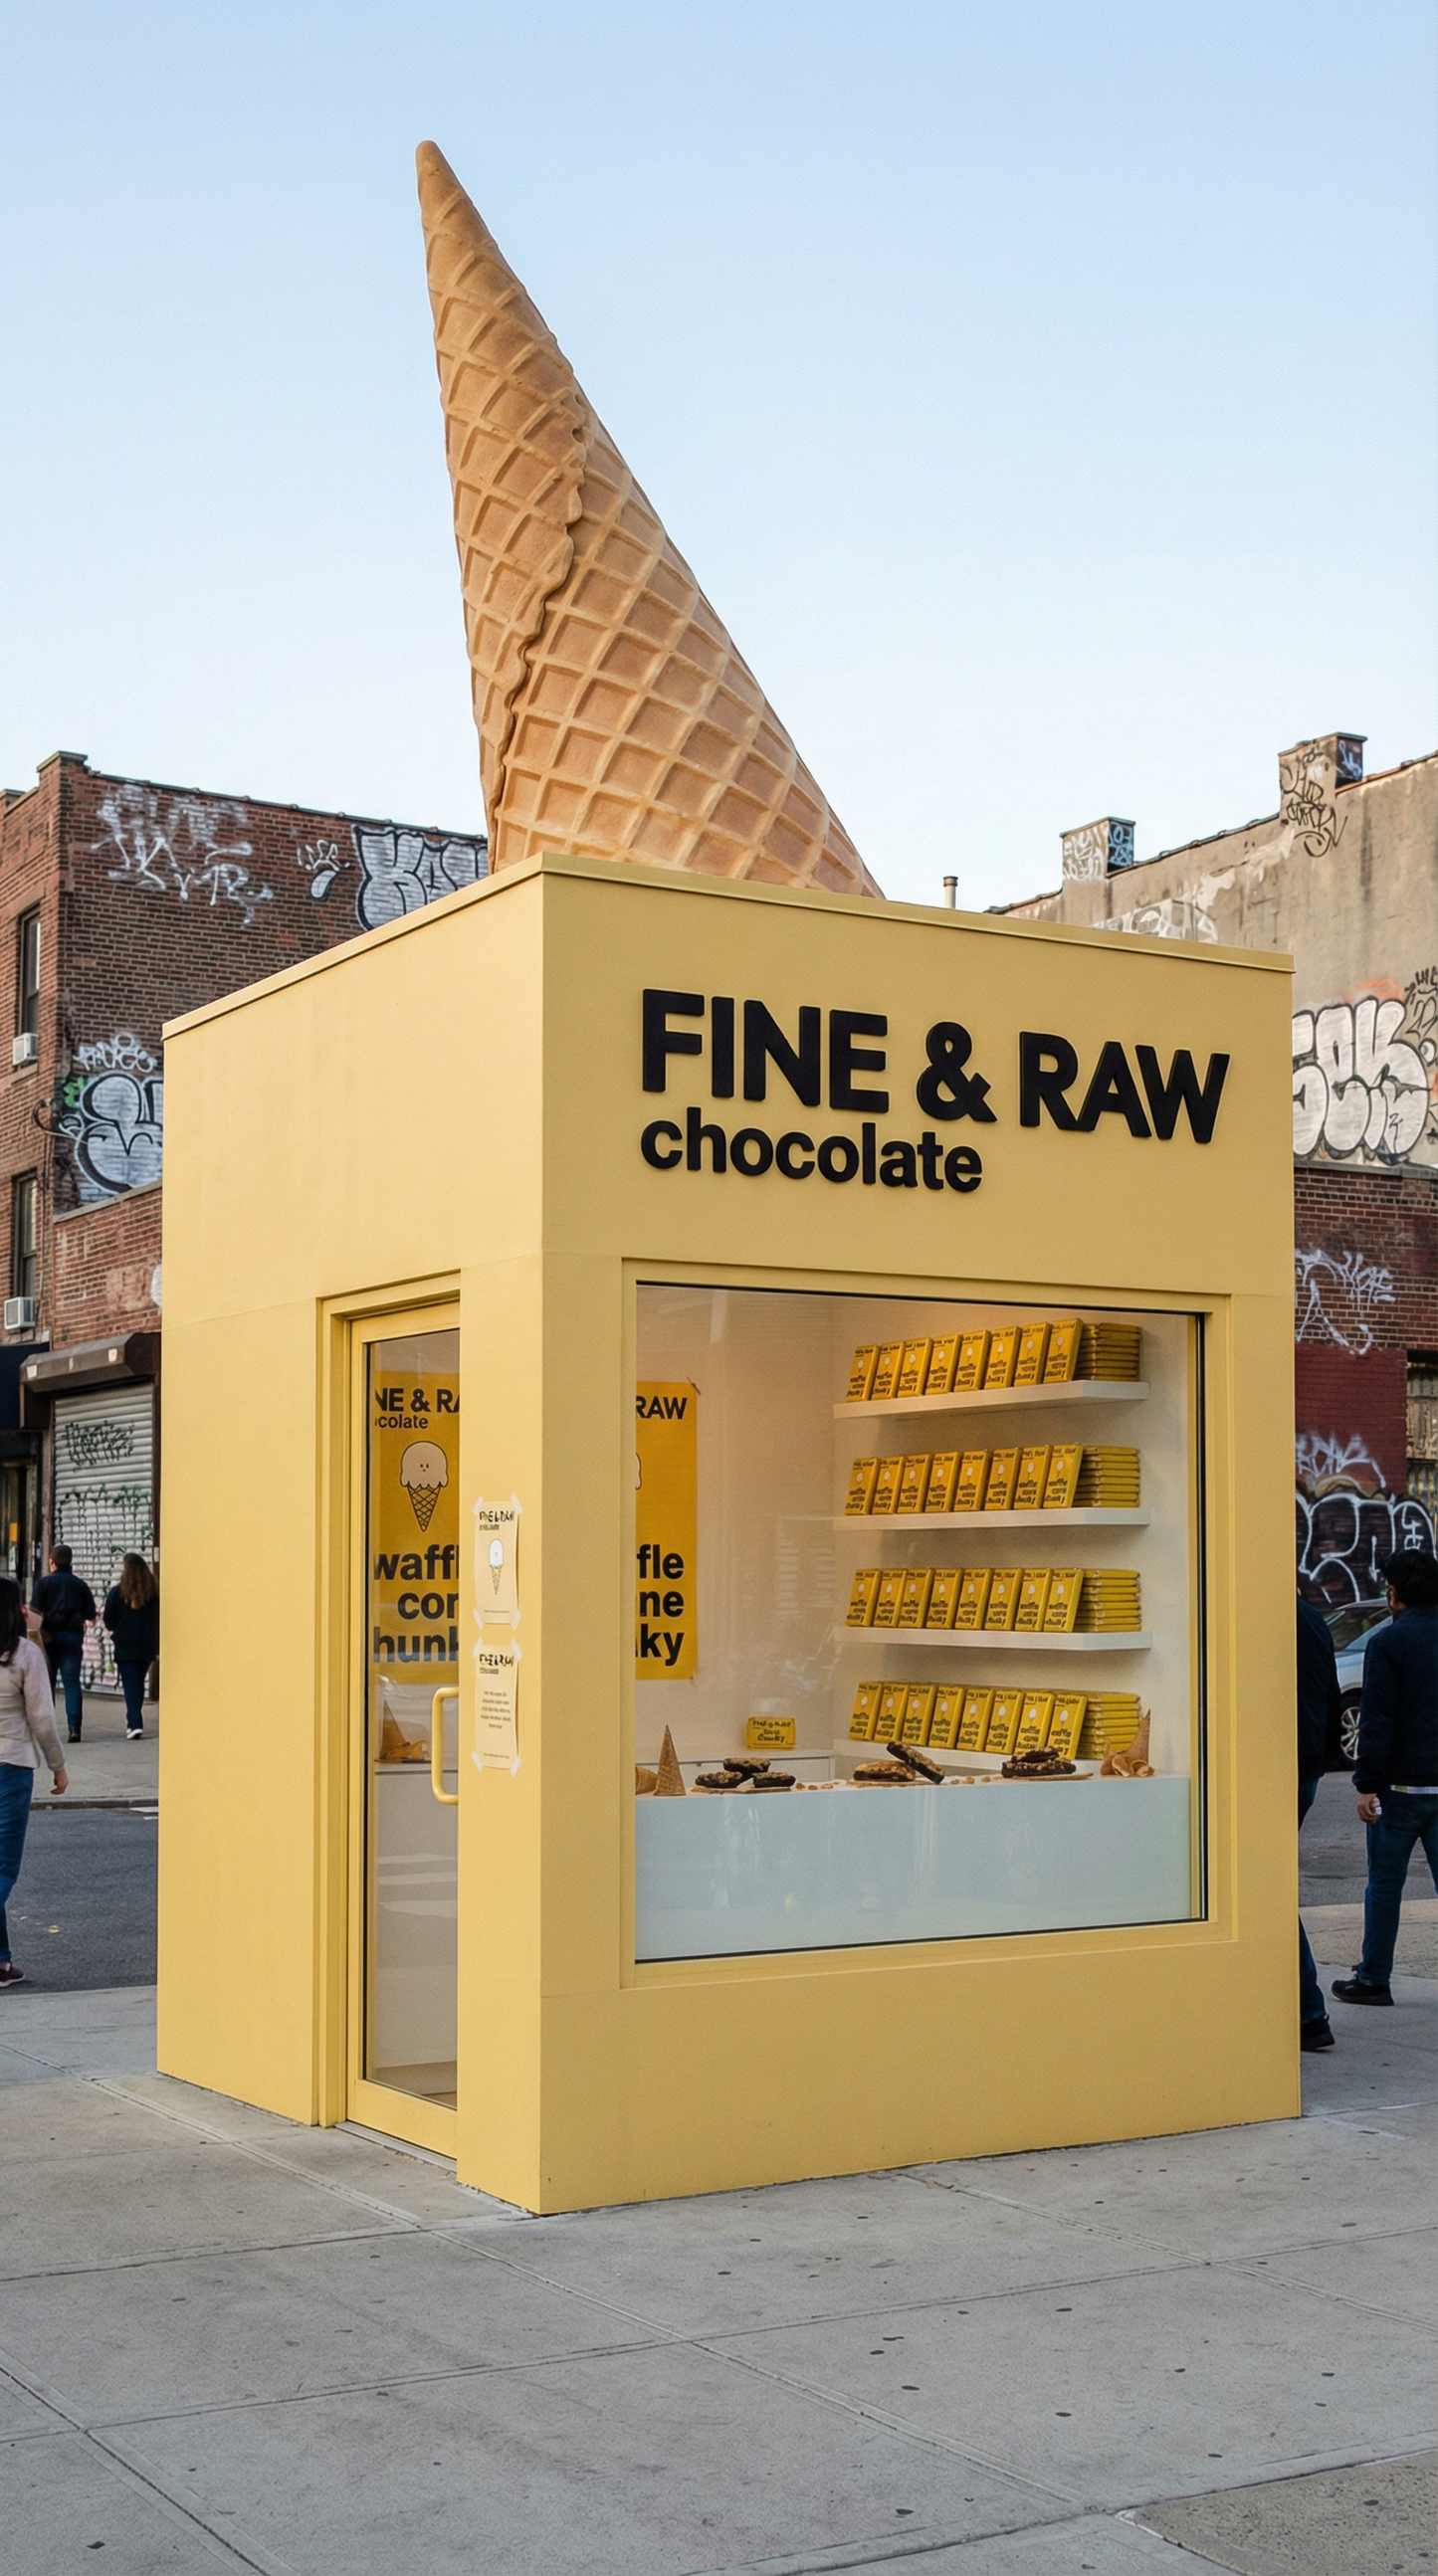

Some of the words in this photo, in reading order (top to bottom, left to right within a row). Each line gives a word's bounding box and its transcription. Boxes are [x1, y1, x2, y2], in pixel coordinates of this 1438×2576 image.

[643, 989, 889, 1113] FINE
[917, 1022, 997, 1123] &
[1020, 1032, 1230, 1144] RAW
[641, 1107, 982, 1193] chocolate
[410, 1388, 431, 1412] &
[636, 1396, 688, 1420] RAW
[375, 1414, 429, 1429] colate
[636, 1544, 684, 1580] fle
[639, 1591, 684, 1618] ne
[635, 1623, 685, 1667] ky
